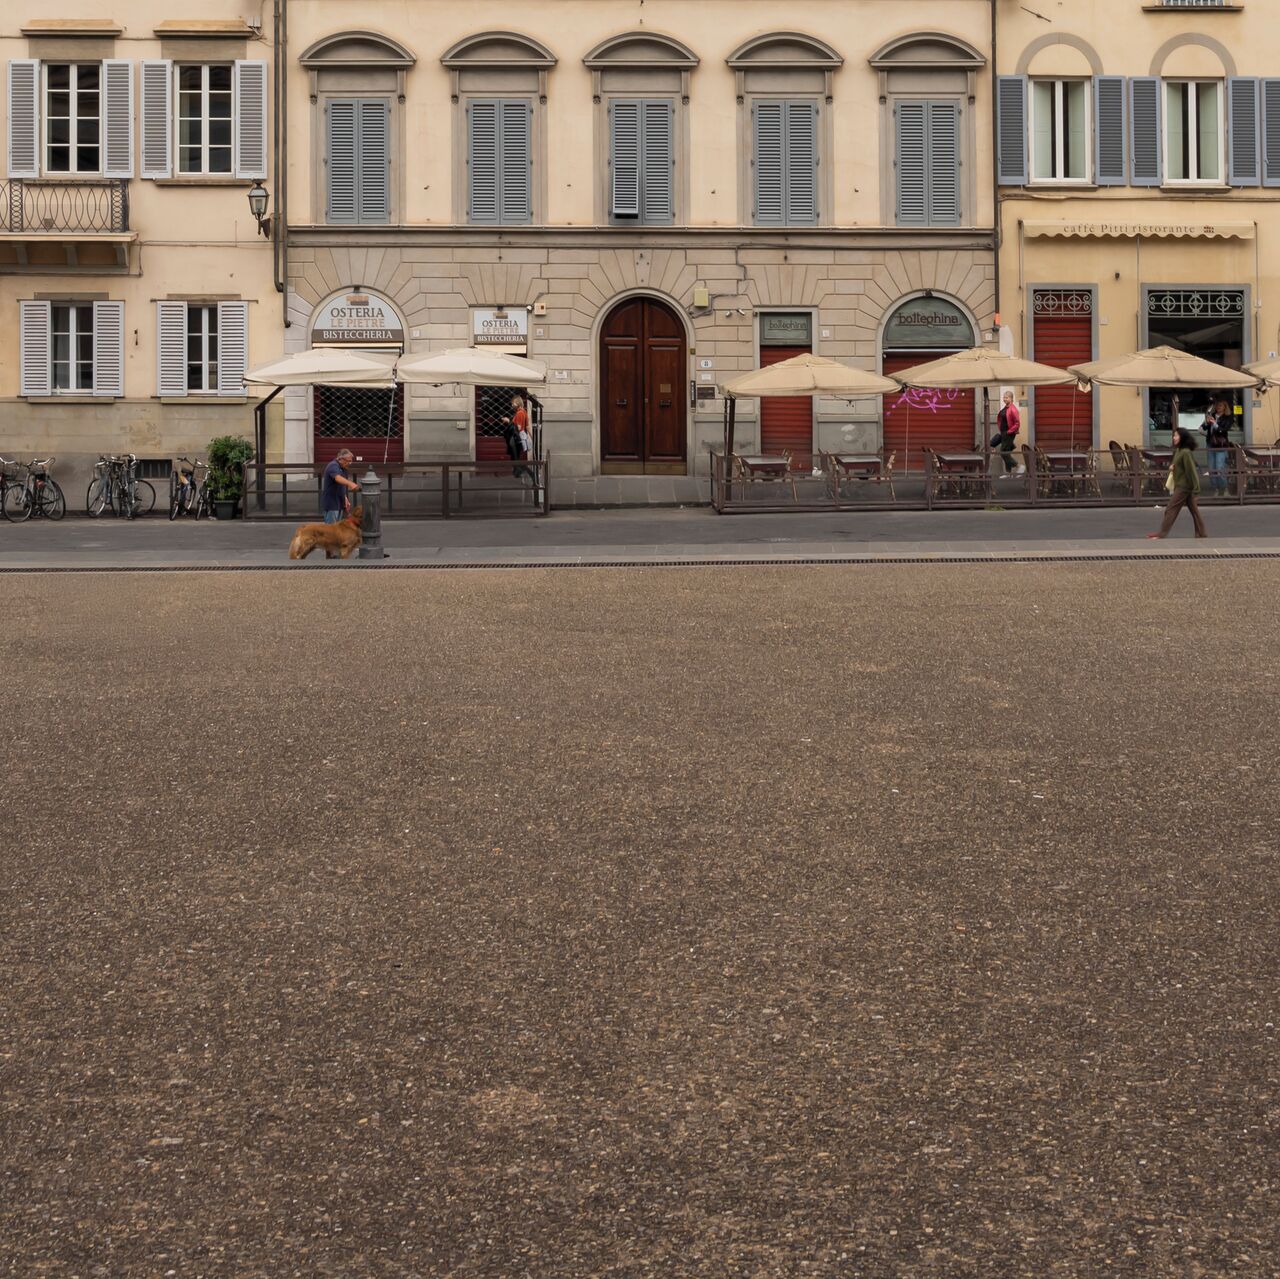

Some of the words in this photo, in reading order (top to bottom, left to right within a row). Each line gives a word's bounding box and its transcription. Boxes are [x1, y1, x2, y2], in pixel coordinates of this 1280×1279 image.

[1101, 223, 1128, 233] Pitti
[1132, 223, 1196, 233] ristorante
[330, 307, 385, 318] OSTERIA
[330, 319, 344, 328] LE
[346, 319, 385, 328] PIETRE
[481, 319, 519, 328] OSTERIA
[323, 330, 393, 339] BISTECCHERIA
